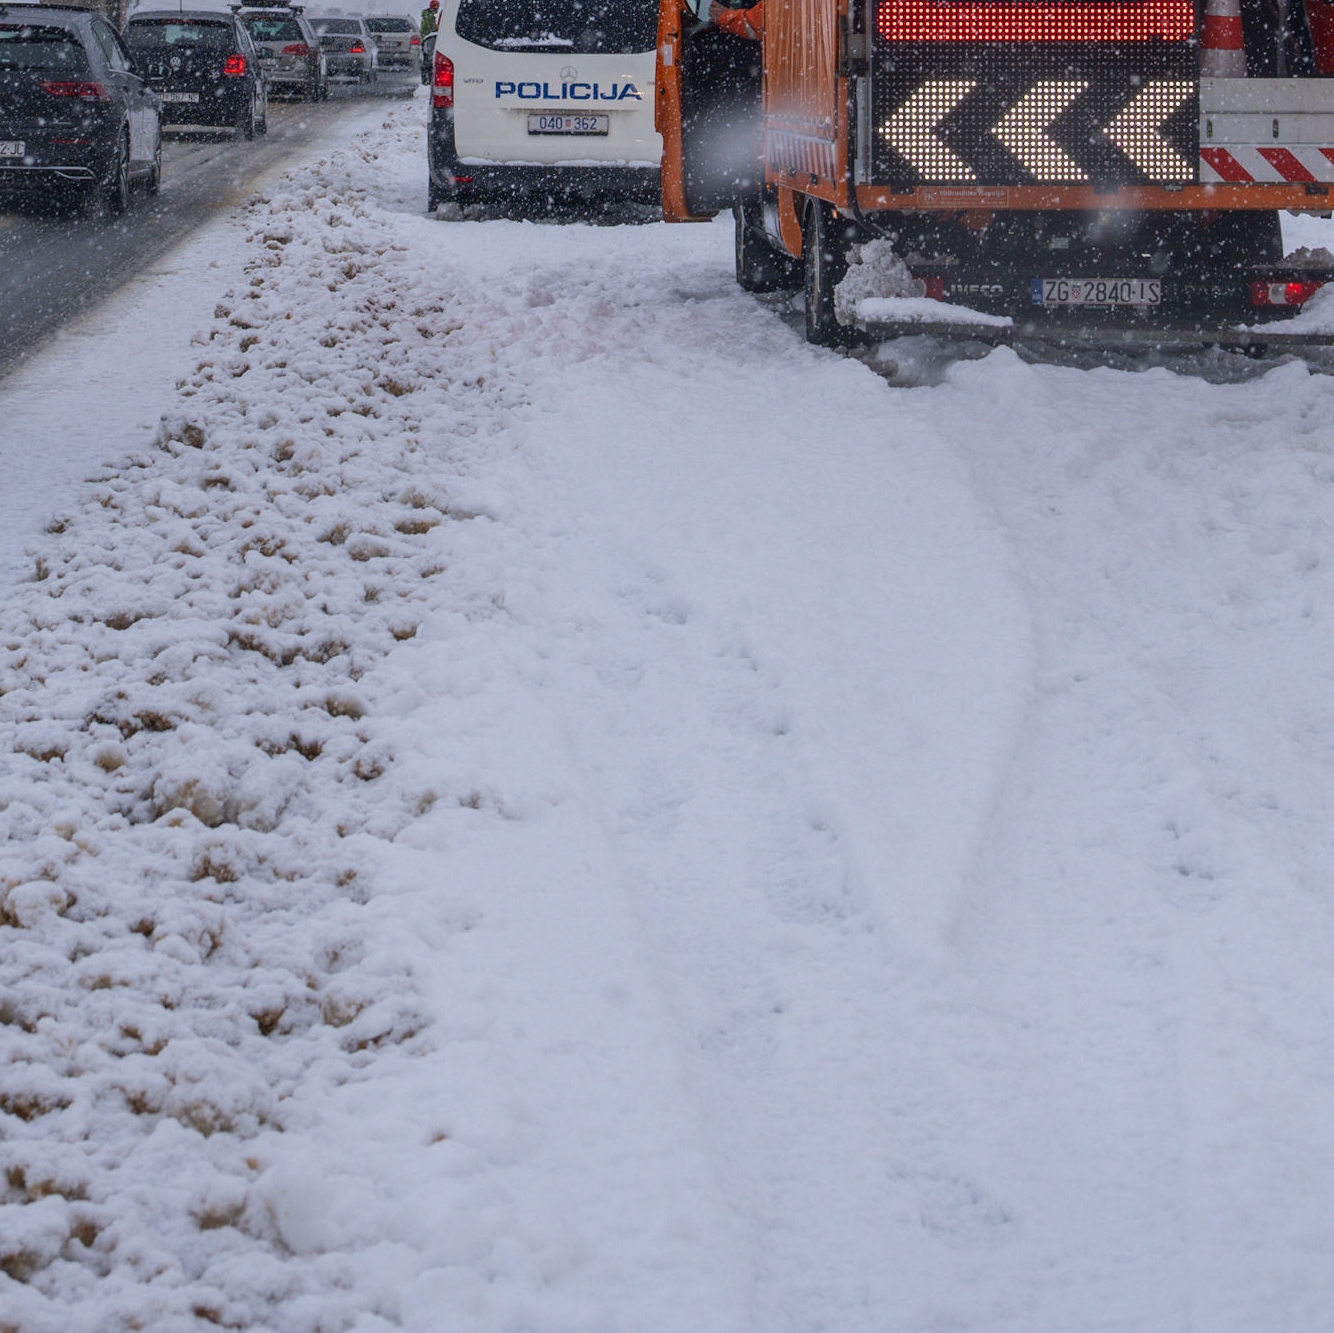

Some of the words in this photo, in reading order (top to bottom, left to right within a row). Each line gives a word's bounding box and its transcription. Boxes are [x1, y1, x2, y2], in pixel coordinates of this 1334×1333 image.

[495, 81, 643, 101] POLICIJA
[539, 116, 563, 130] 040
[573, 117, 597, 130] 362
[950, 284, 1004, 297] IVECO
[1045, 281, 1069, 302] ZG
